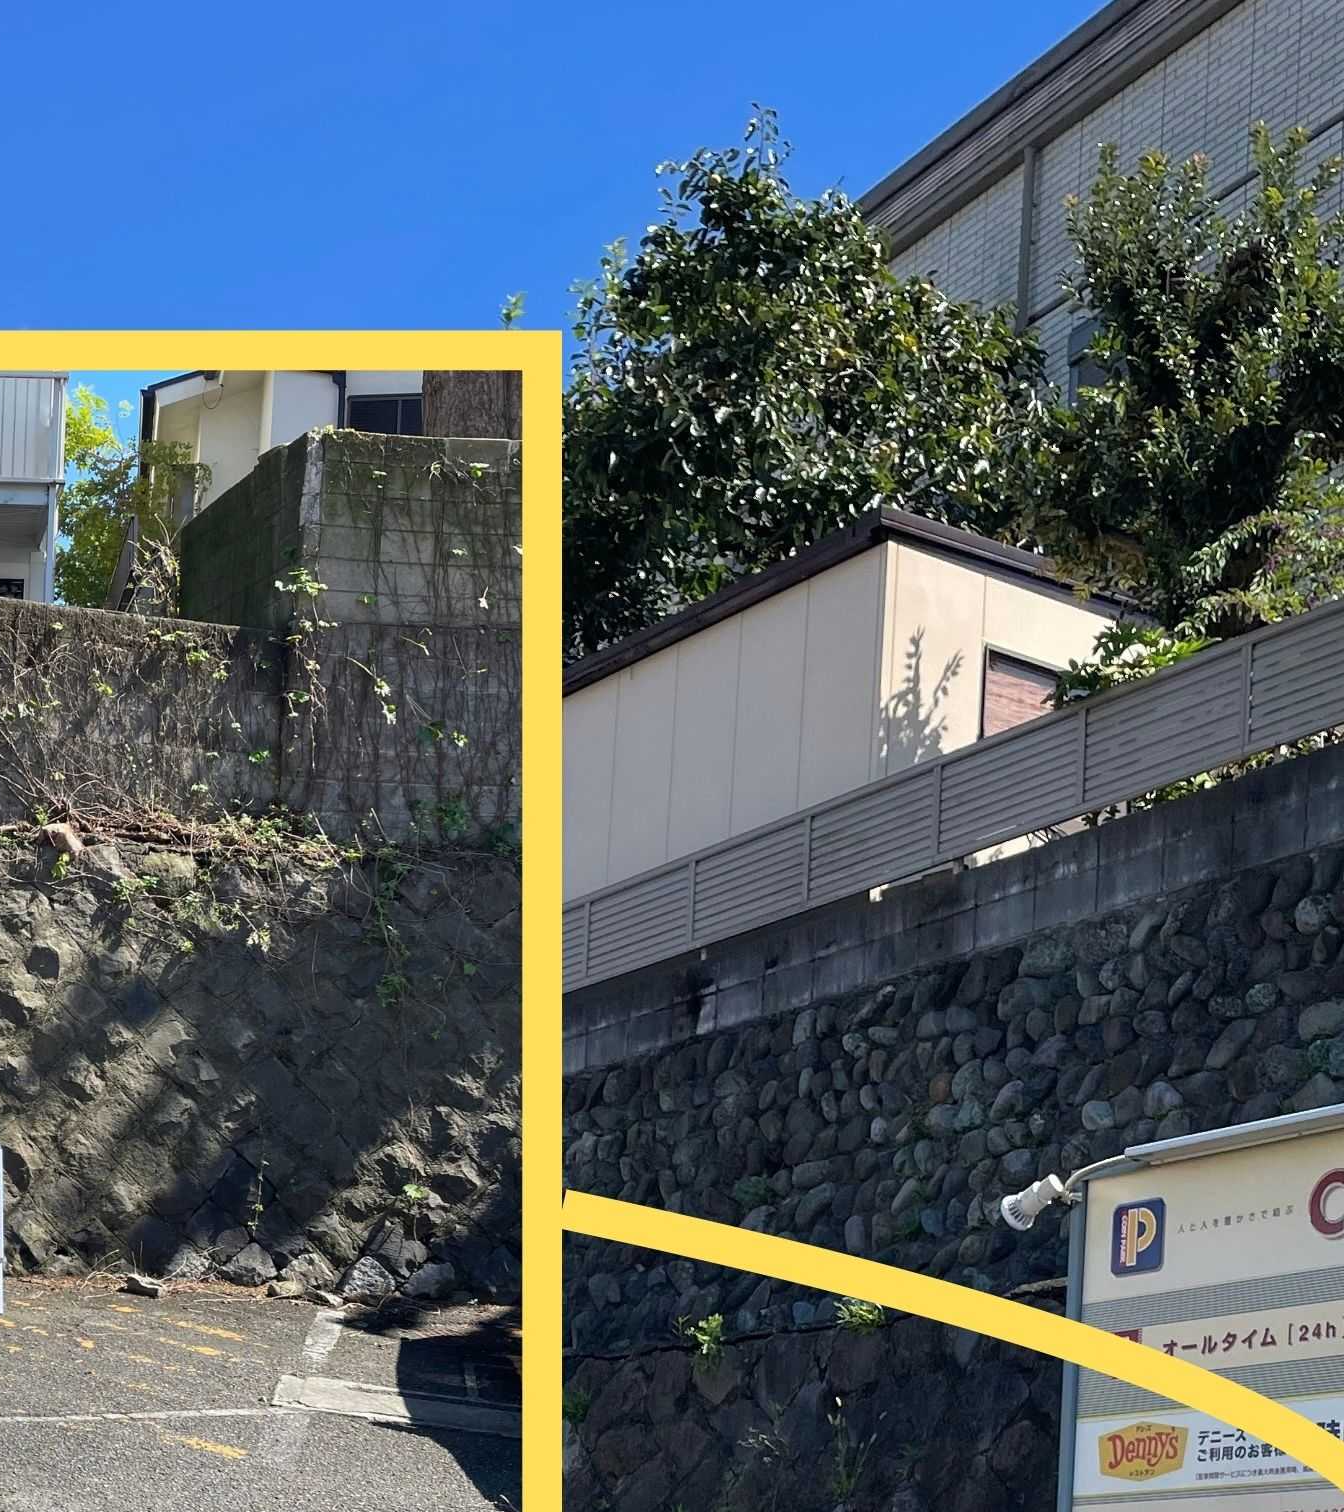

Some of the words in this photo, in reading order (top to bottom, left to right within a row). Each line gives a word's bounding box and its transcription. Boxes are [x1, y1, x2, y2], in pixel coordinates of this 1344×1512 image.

[1162, 1327, 1278, 1356] オールタイム
[1107, 1430, 1180, 1470] Denny's
